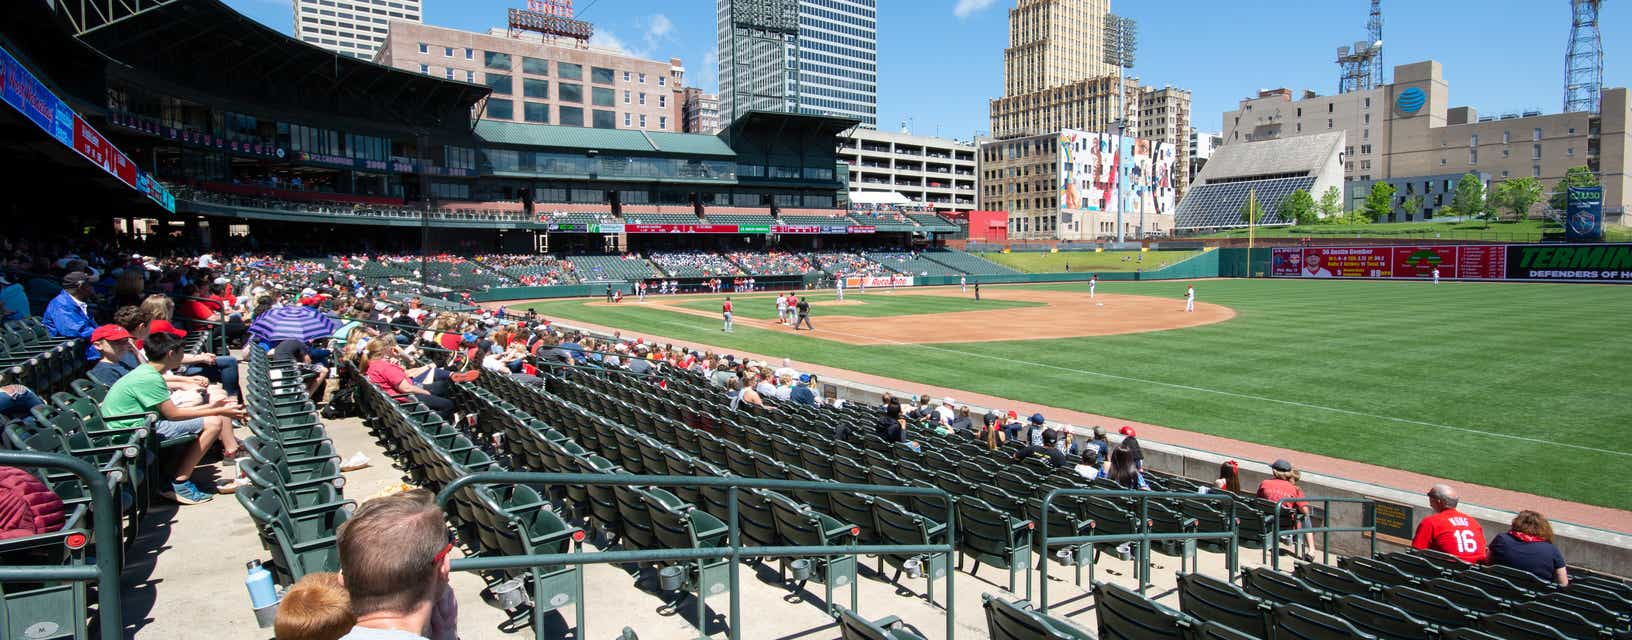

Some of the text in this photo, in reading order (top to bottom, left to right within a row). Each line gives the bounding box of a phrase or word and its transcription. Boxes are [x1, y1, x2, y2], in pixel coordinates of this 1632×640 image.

[1529, 270, 1599, 279] DEFENDERS
[1601, 270, 1619, 279] OF
[872, 277, 907, 287] Autoone
[1453, 529, 1478, 553] 16
